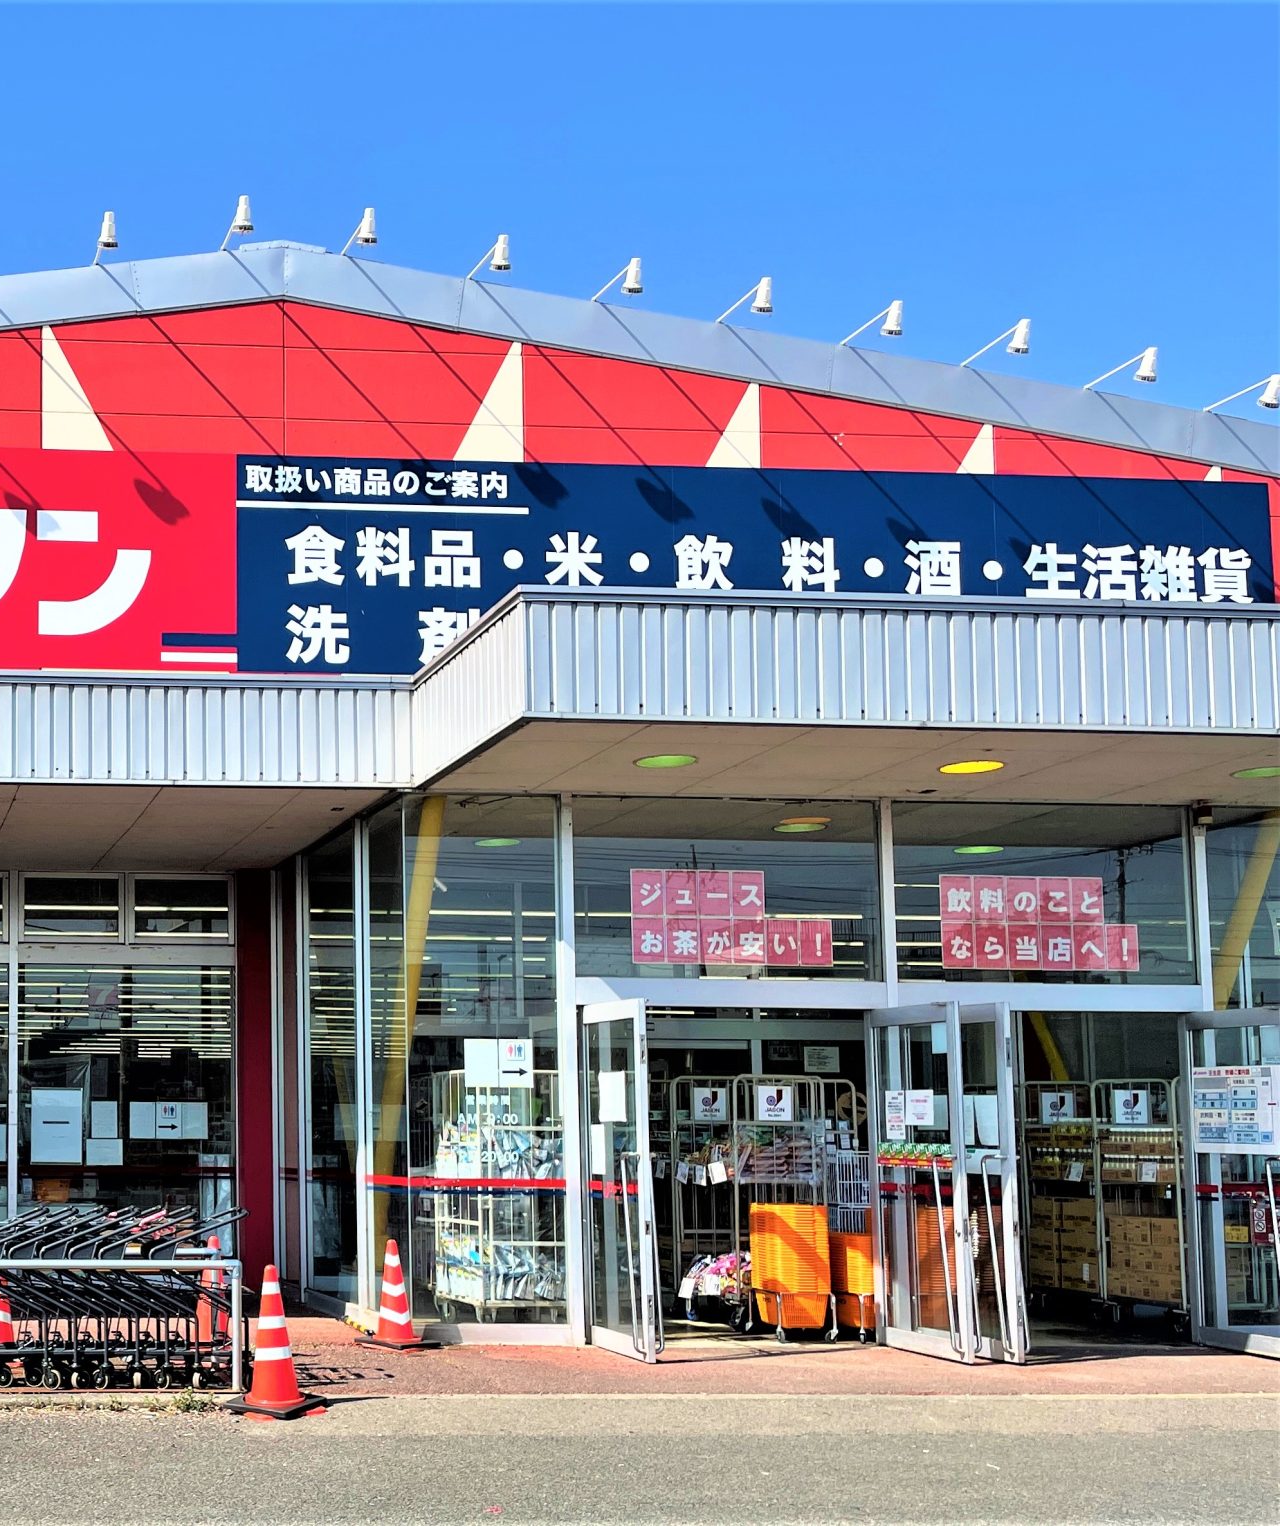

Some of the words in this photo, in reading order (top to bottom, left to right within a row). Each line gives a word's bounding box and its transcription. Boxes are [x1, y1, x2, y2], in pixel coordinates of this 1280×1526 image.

[245, 463, 509, 499] 取扱い商品のご案内
[639, 883, 762, 907] ジュース
[946, 887, 1101, 915] 飲料のこと
[640, 929, 823, 957] お茶が安い！
[950, 935, 1129, 963] なら当店へ！
[481, 1150, 519, 1163] 2000
